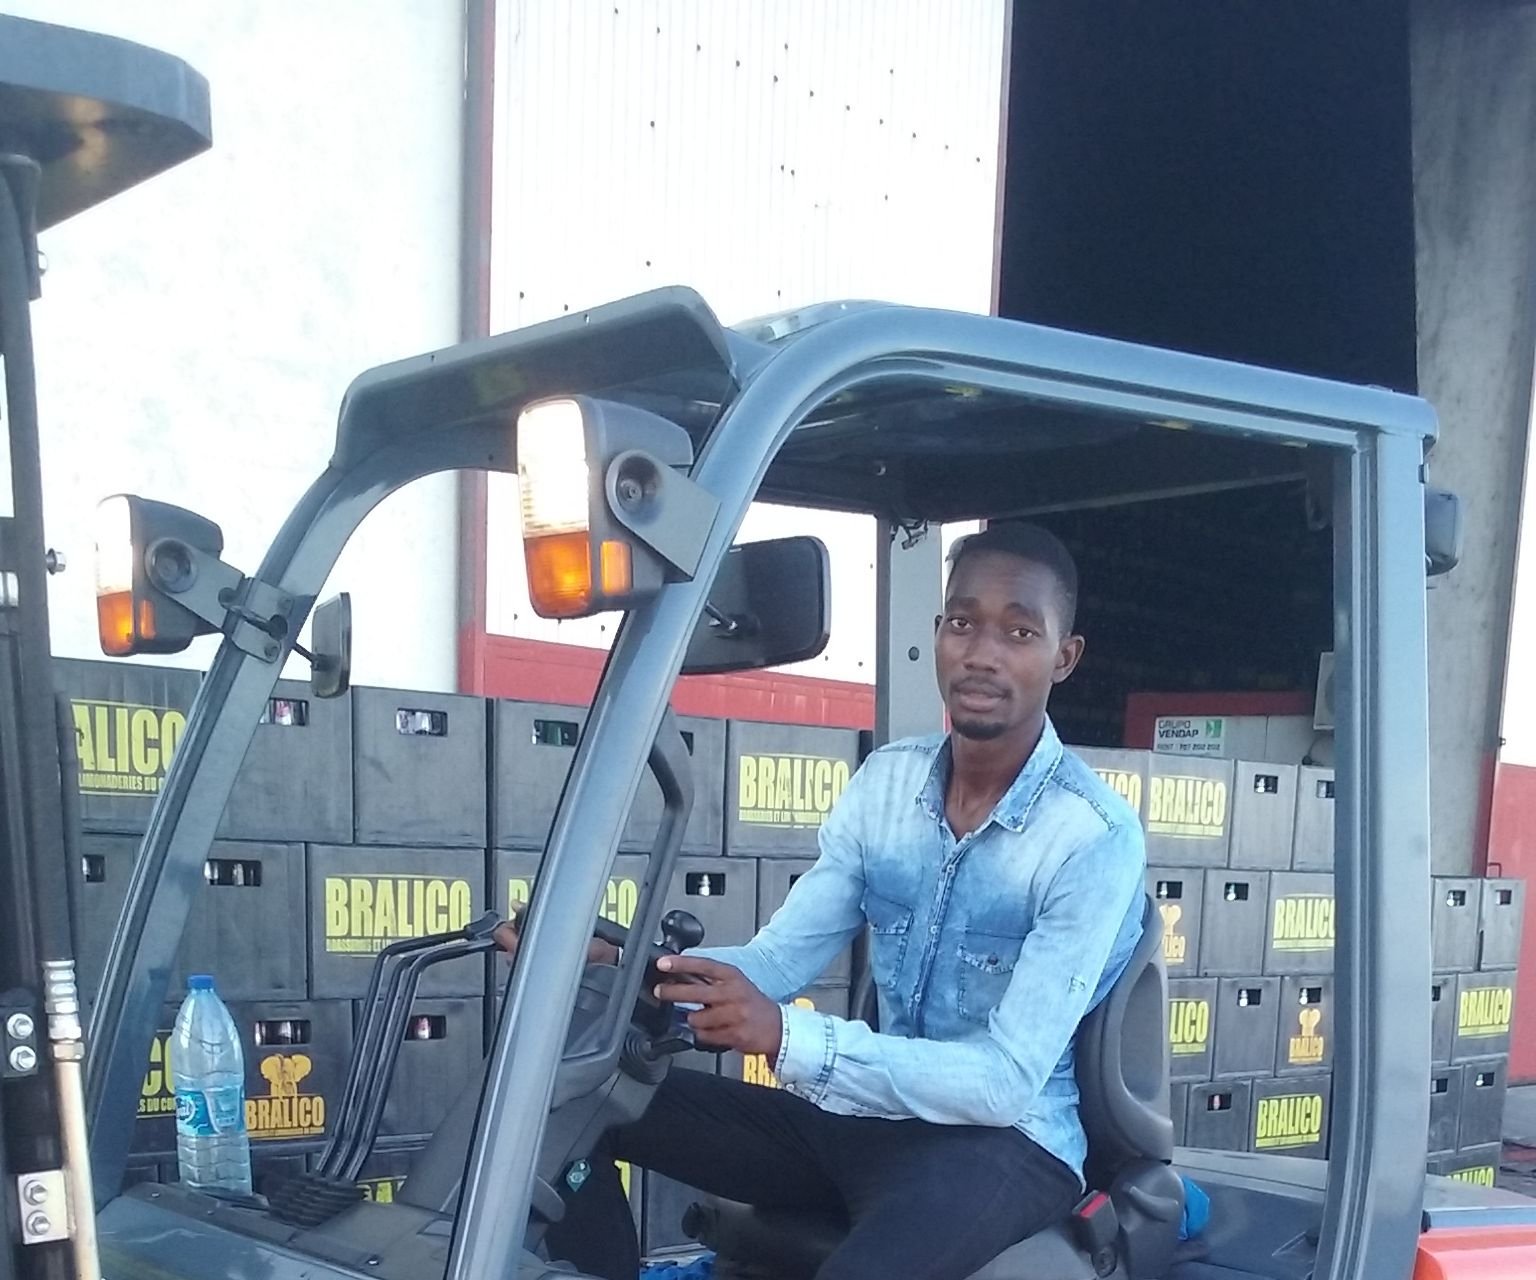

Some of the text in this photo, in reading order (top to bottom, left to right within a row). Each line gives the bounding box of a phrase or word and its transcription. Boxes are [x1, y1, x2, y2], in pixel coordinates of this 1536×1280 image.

[71, 704, 187, 775] ALICO
[1158, 729, 1199, 738] VENDAP
[739, 756, 849, 812] BRALICO
[1149, 777, 1226, 825] BRALICO
[325, 878, 471, 937] BRALICO
[1170, 1001, 1209, 1043] LICO
[1459, 988, 1512, 1027] BRALICO
[245, 1096, 325, 1131] BRALICO
[1256, 1095, 1322, 1138] BRALICO
